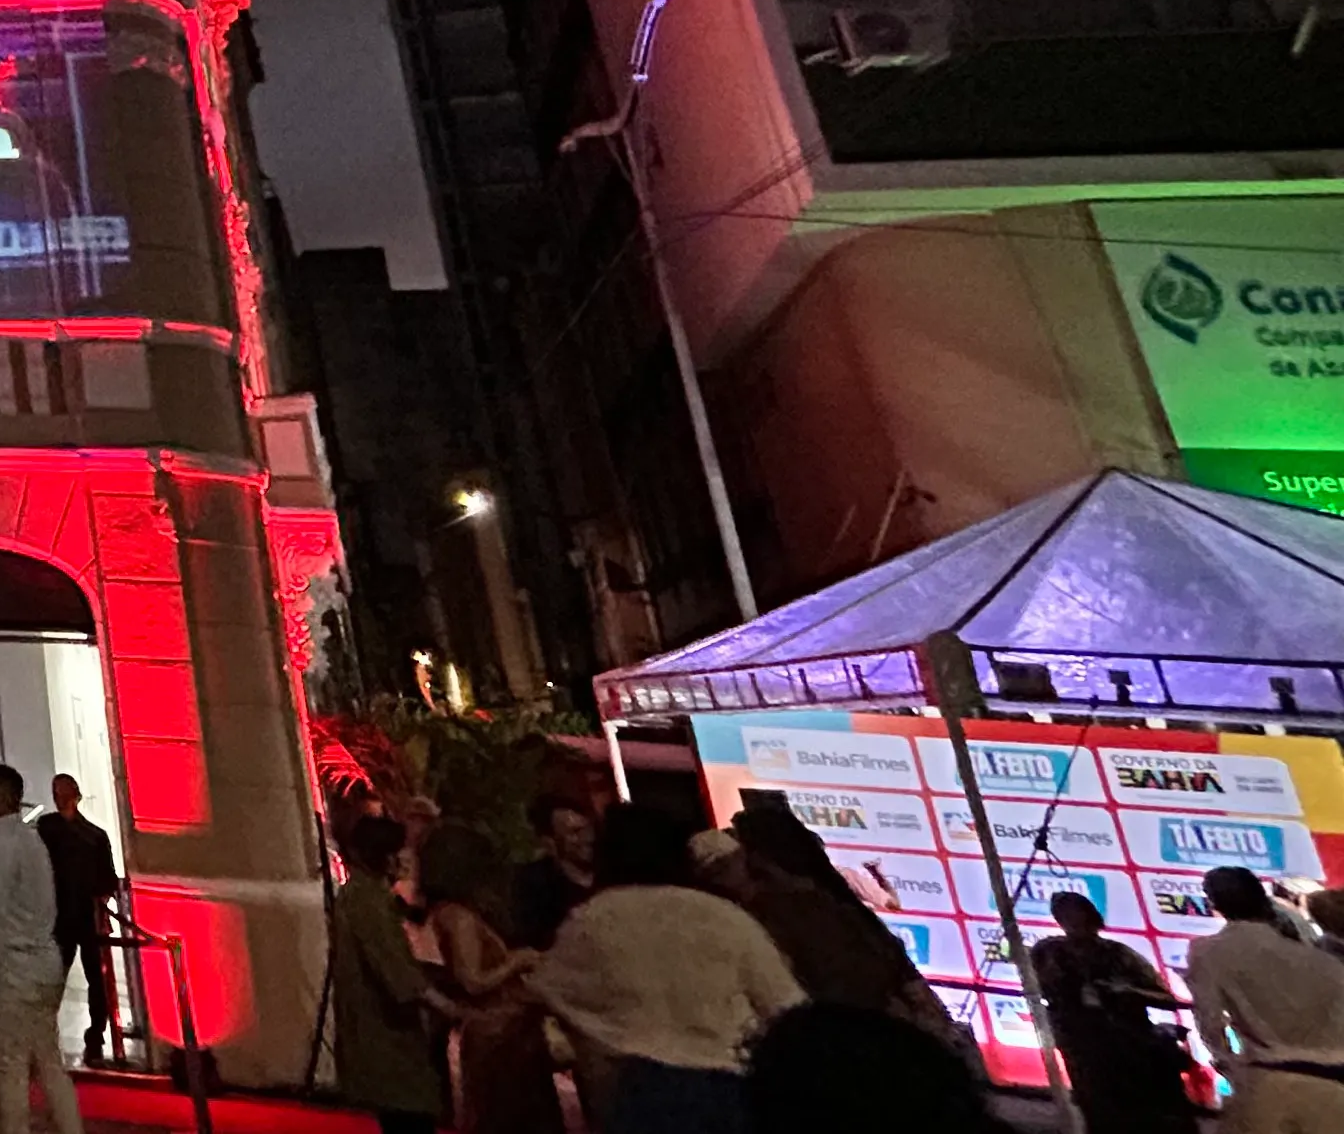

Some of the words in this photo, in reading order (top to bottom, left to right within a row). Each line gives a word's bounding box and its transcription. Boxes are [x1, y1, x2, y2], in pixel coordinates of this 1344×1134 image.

[1110, 754, 1190, 770] GOVERNO
[1195, 757, 1218, 771] DA
[1115, 766, 1226, 794] BAHIA
[841, 794, 863, 807] DA
[1201, 825, 1268, 855] FEITO
